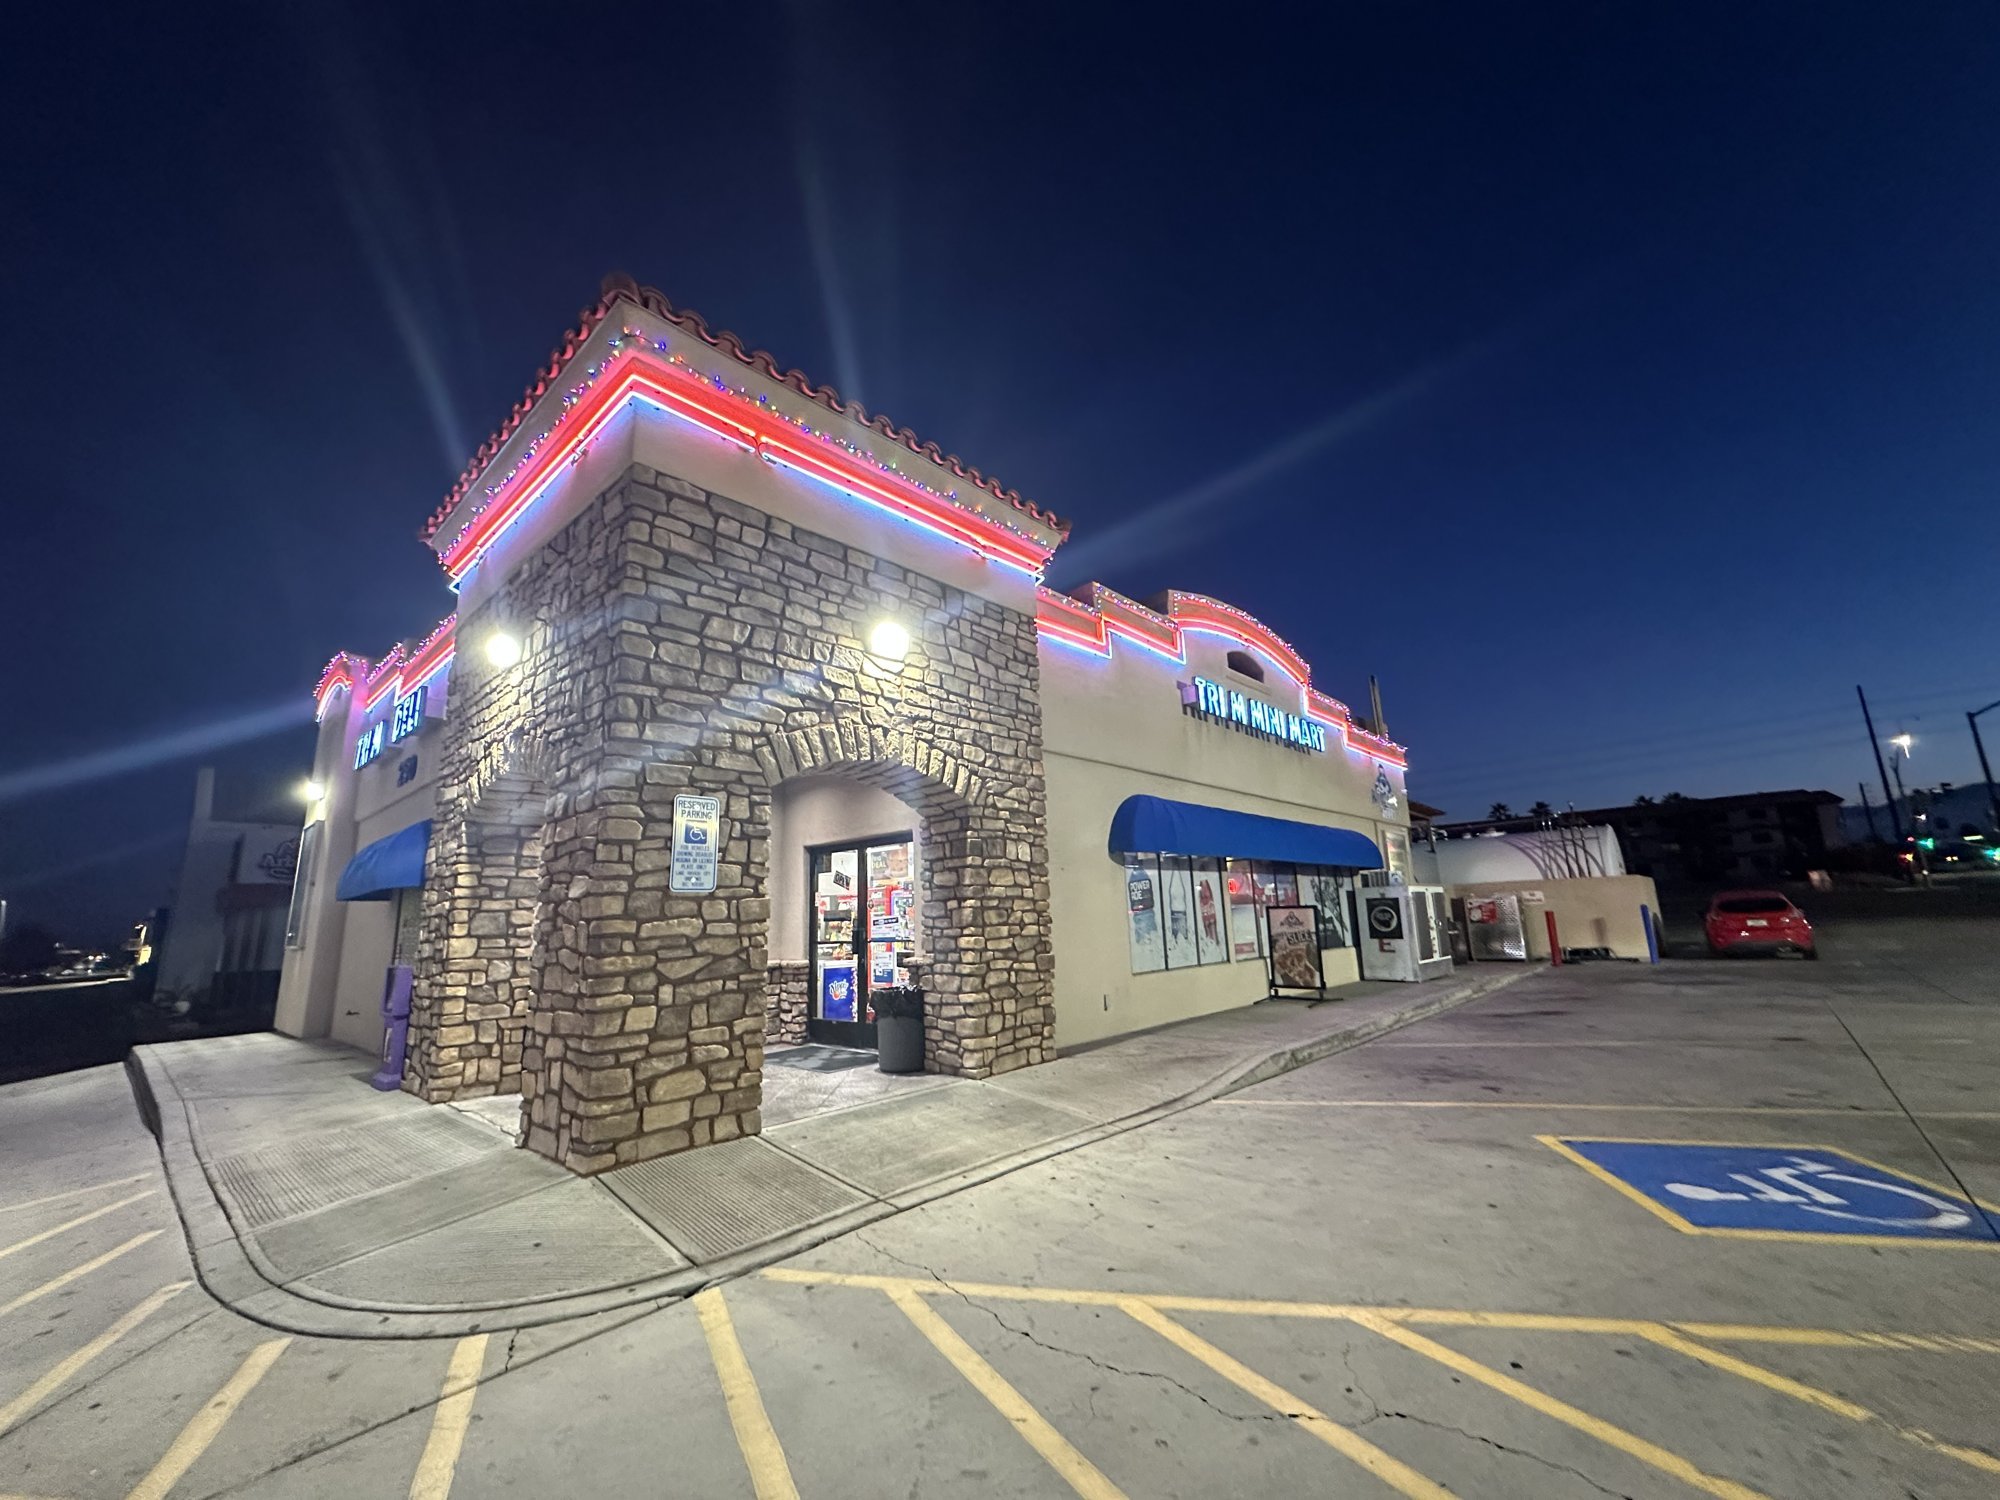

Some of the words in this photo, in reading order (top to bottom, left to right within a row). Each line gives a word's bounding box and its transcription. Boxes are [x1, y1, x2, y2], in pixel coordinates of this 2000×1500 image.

[1194, 676, 1228, 718] TRI
[1229, 689, 1248, 726] M
[1250, 699, 1287, 739] MINI
[1288, 714, 1325, 752] MART
[679, 800, 715, 811] RESERVED
[681, 810, 712, 820] PARKING
[1129, 880, 1151, 892] POWER
